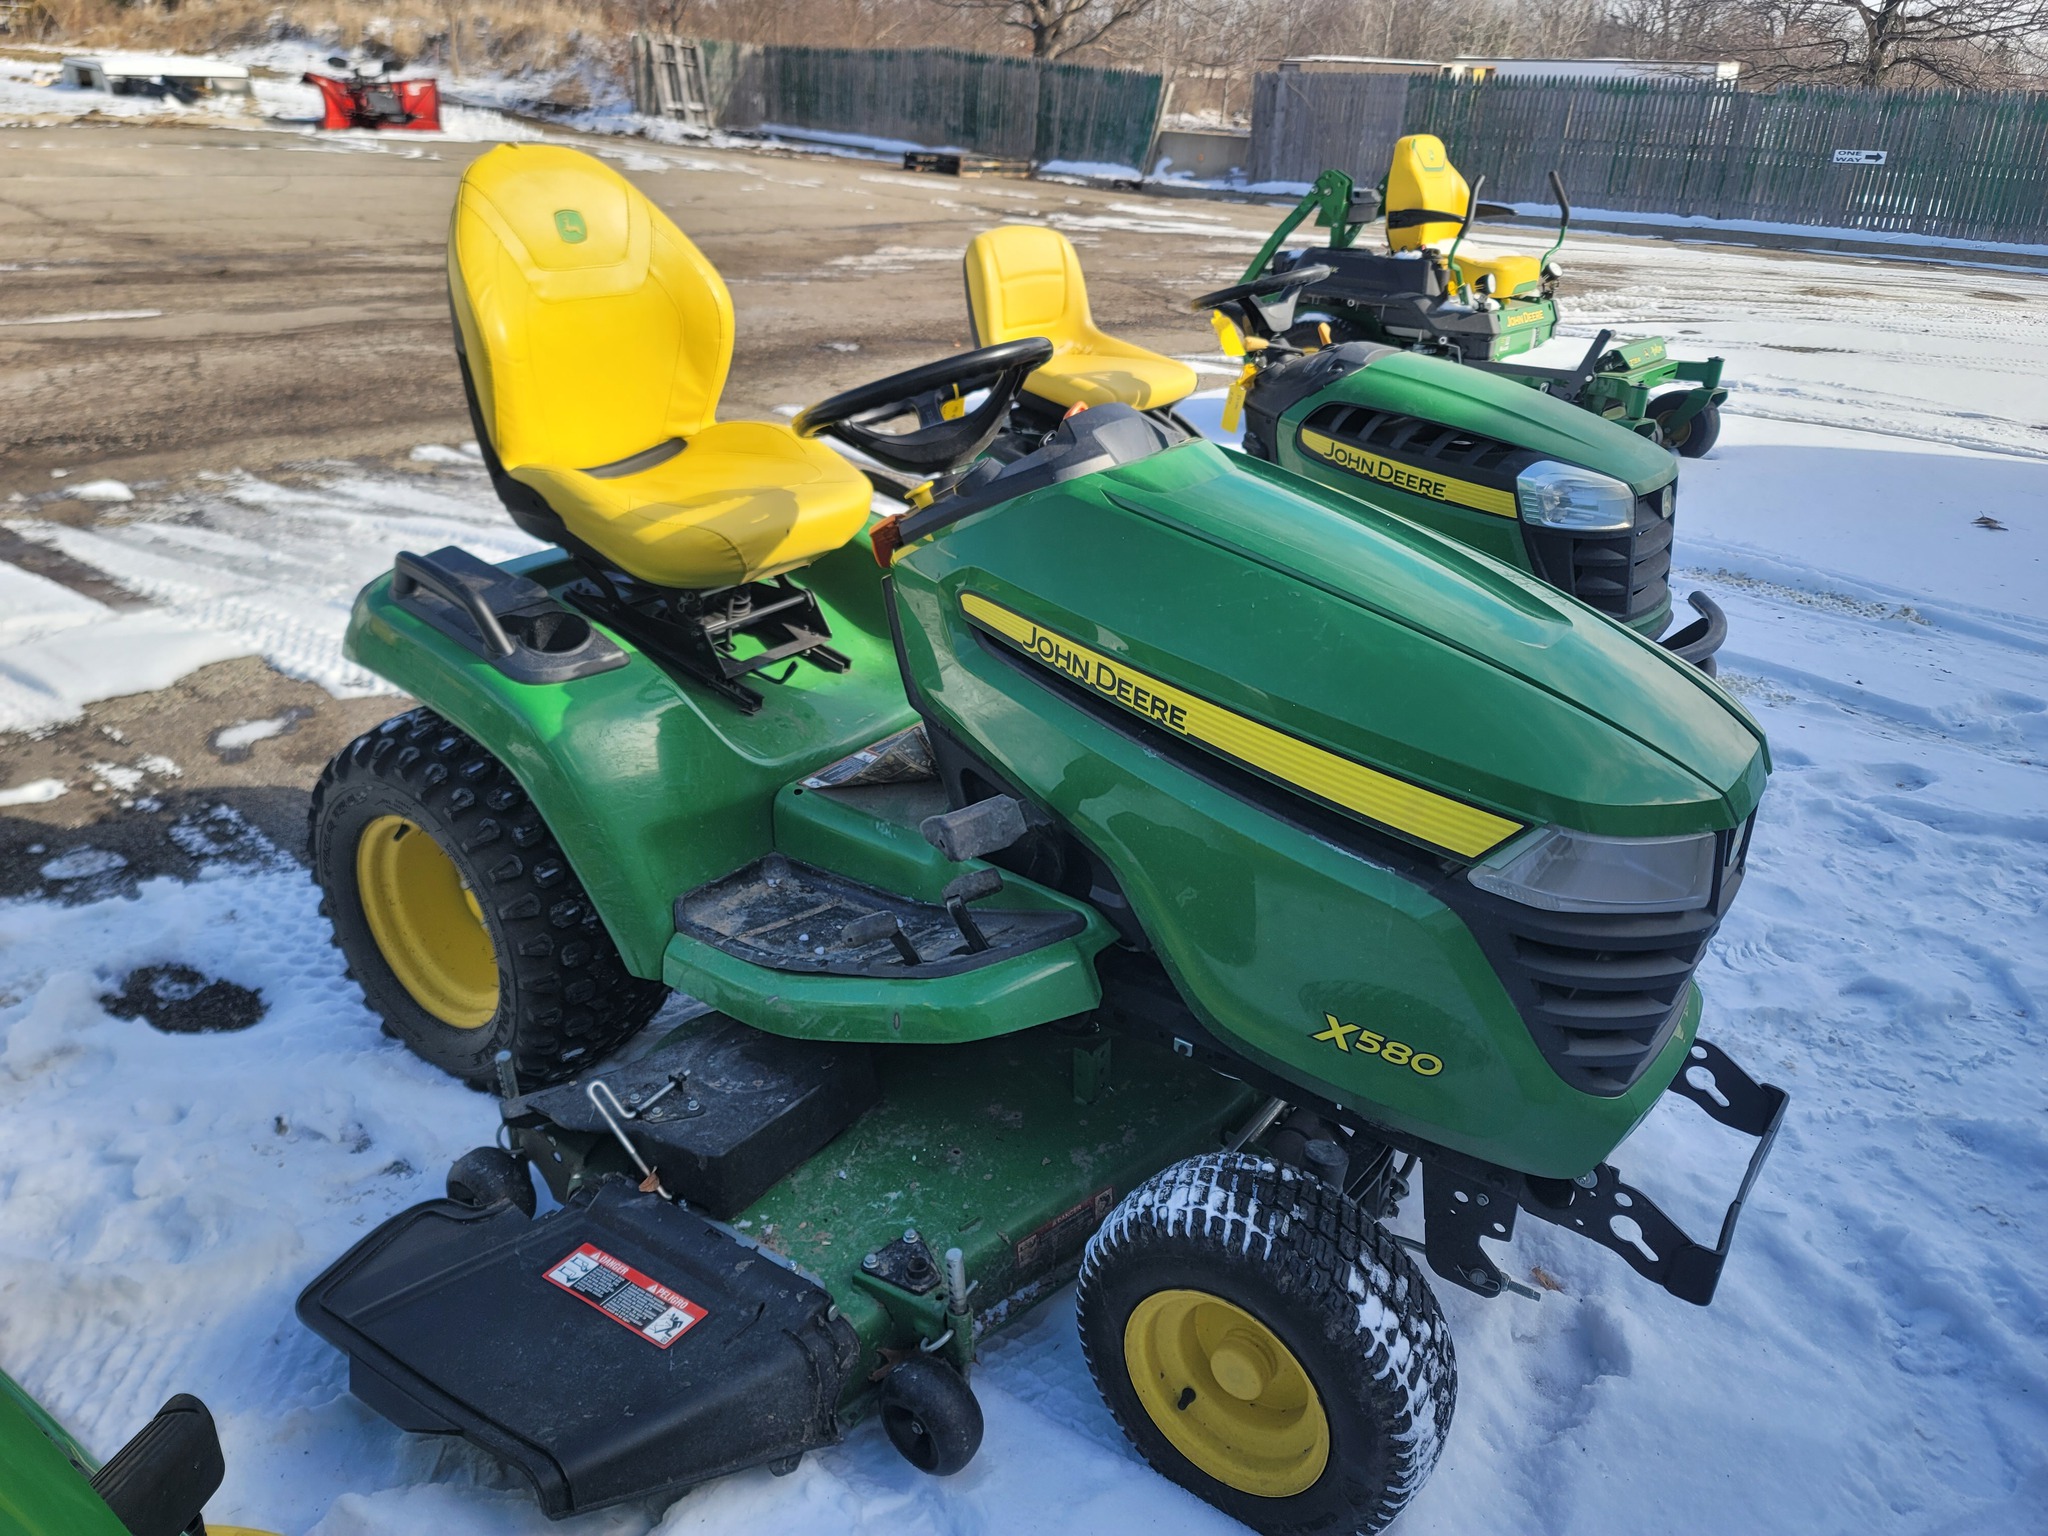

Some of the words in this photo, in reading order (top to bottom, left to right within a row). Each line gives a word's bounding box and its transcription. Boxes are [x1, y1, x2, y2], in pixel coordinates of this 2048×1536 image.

[1507, 315, 1524, 327] JOHN
[1523, 310, 1544, 323] DEERE
[1324, 442, 1374, 473] JOHN
[1378, 461, 1446, 498] DEERE
[1023, 627, 1090, 681] JOHN
[1096, 662, 1188, 731] DEERE
[1310, 1012, 1444, 1077] X580
[599, 1254, 630, 1276] DANGER
[656, 1287, 690, 1310] PELIGRO
